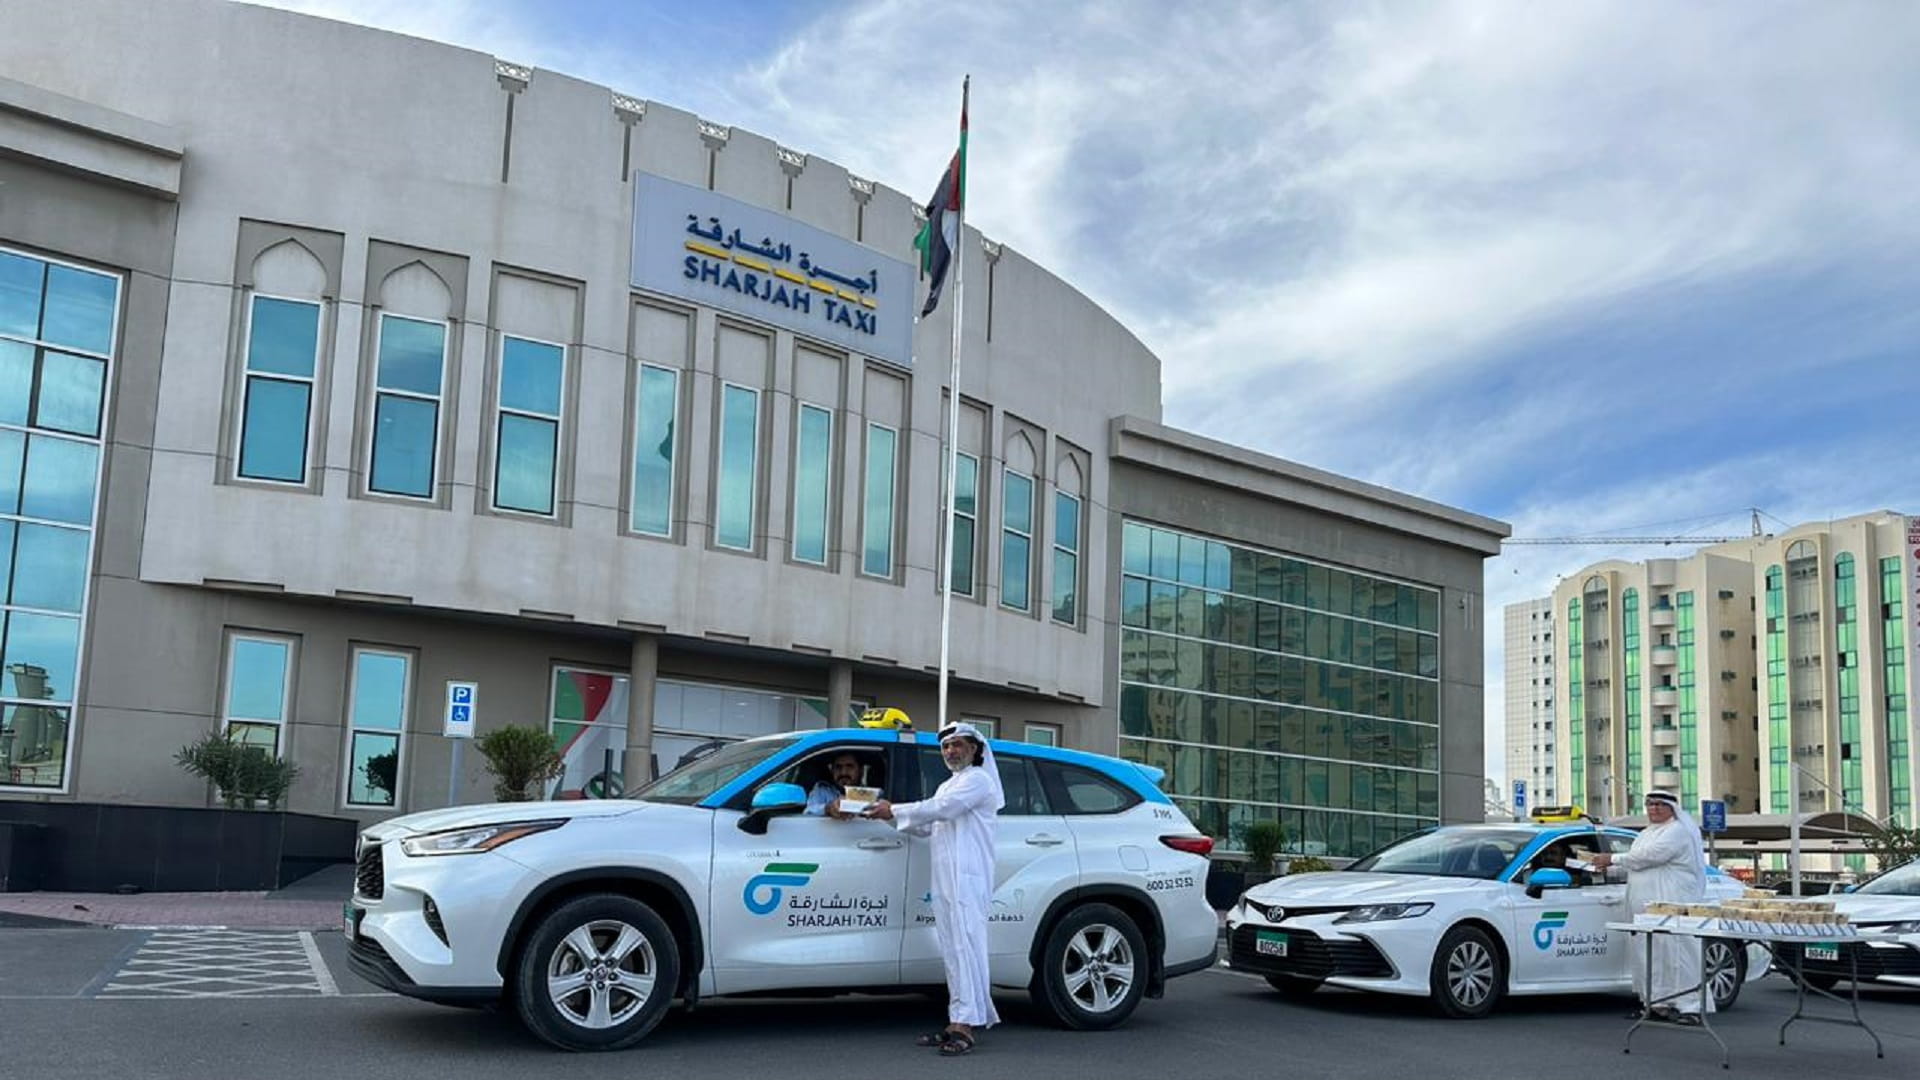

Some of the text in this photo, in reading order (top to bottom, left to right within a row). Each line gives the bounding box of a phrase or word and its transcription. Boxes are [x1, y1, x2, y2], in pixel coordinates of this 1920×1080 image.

[686, 214, 877, 294] أجرة الشارقة
[684, 256, 876, 335] SHARJAH TAXI
[456, 687, 468, 701] P
[789, 893, 888, 913] أجرة الشارقة
[787, 914, 888, 927] SHARJAH TAXI
